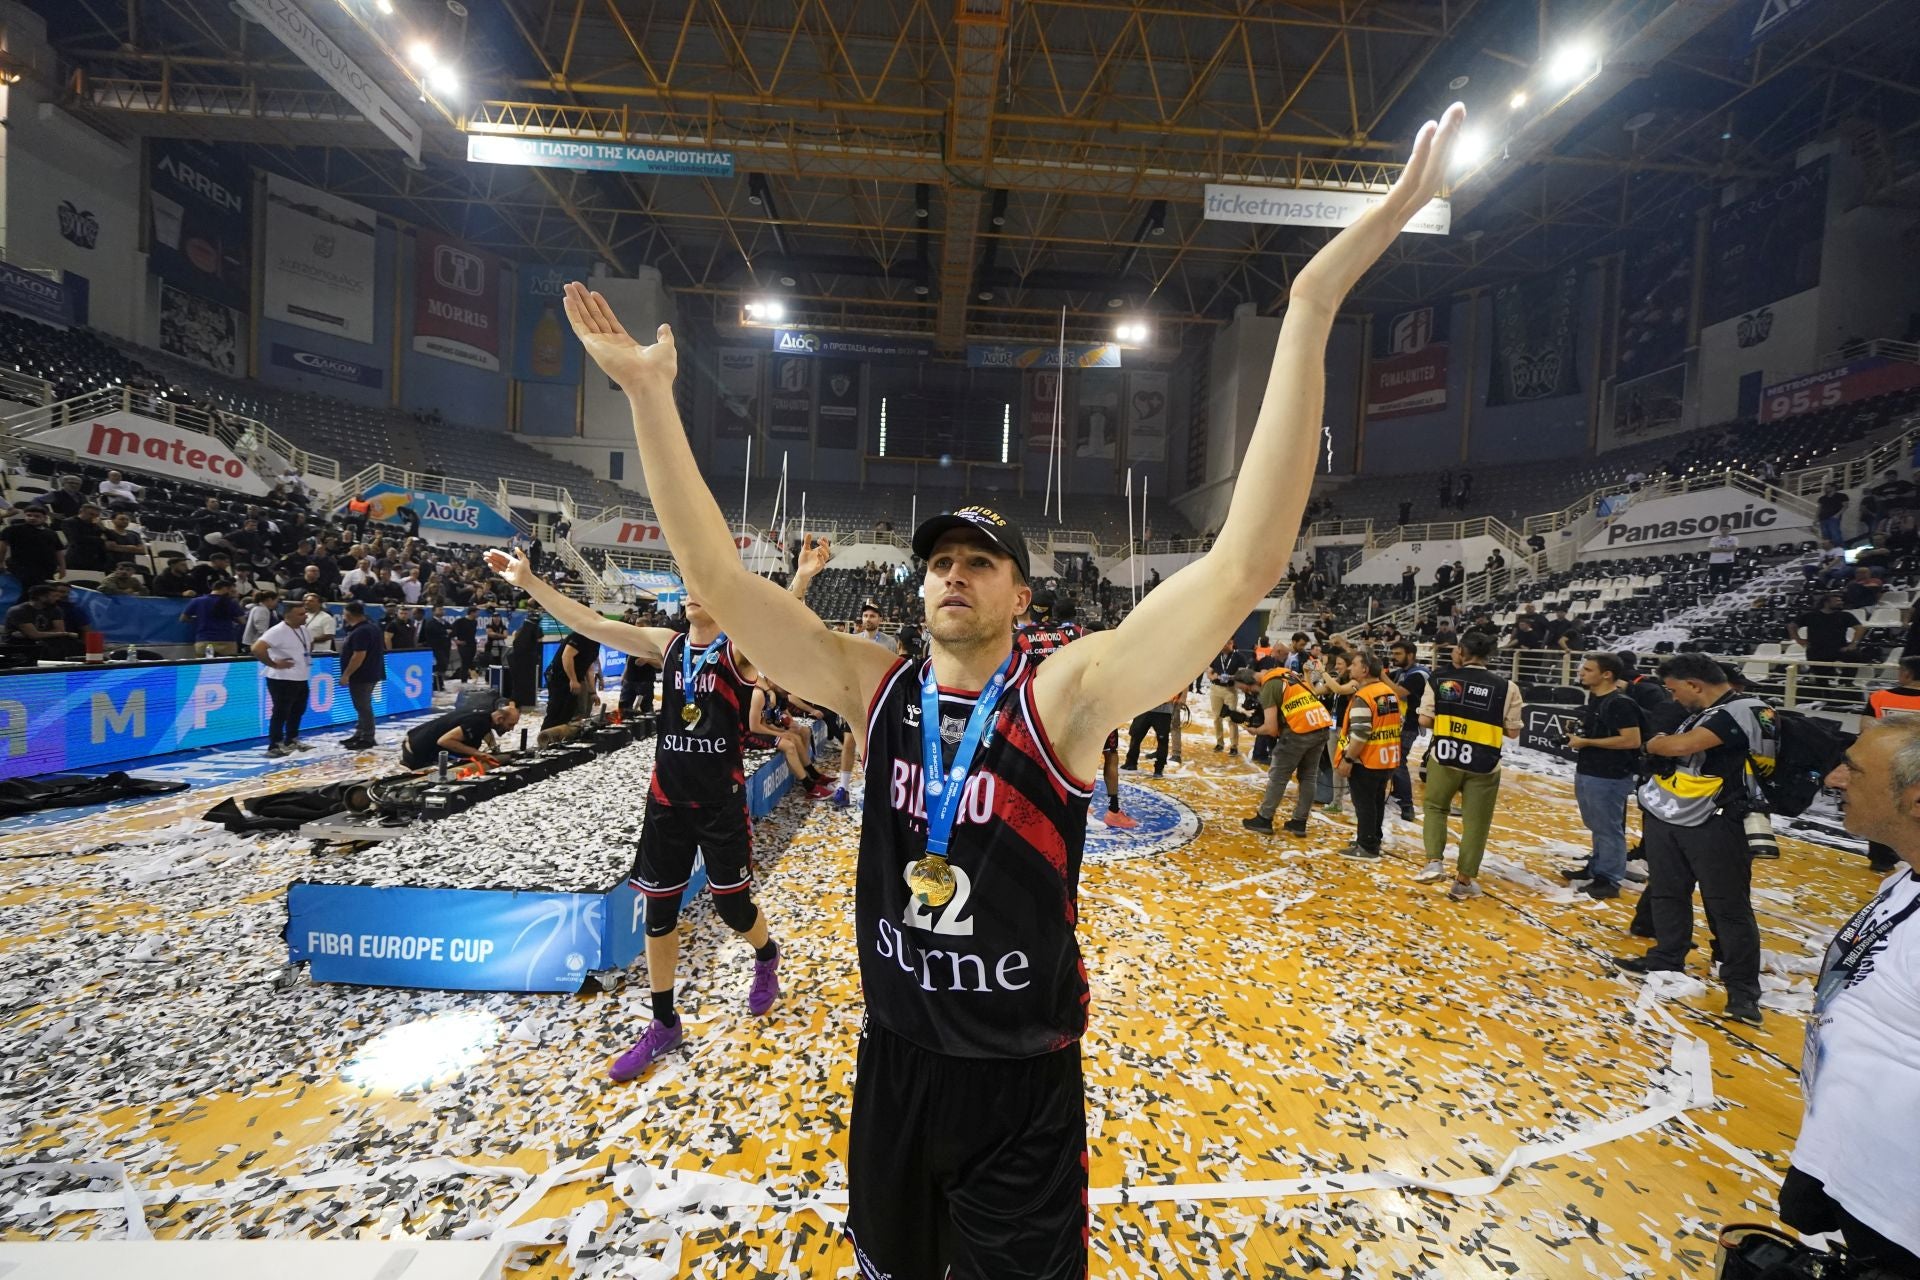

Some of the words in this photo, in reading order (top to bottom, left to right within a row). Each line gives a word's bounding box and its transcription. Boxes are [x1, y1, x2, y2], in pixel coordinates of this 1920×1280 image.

[541, 143, 593, 157] ΓΙΑΤΡΟΙ
[596, 146, 623, 159] ΤΗΣ
[626, 148, 731, 166] ΚΑΘΑΡΙΟΤΗΤΑΣ
[1208, 193, 1348, 221] ticketmaster
[530, 275, 564, 296] λου
[428, 298, 489, 329] MORRIS
[779, 332, 814, 353] Διός
[1767, 366, 1849, 397] METROPOLIS
[1771, 381, 1842, 418] 95.5
[87, 423, 244, 478] mateco
[424, 500, 479, 528] λουξ
[1608, 504, 1777, 545] Panasonic
[1028, 632, 1062, 642] BAGAYOKO
[1034, 646, 1062, 654] CORRE
[674, 670, 717, 693] BBAO
[1468, 685, 1489, 697] FIBA
[663, 734, 727, 754] surne
[1437, 738, 1473, 764] 068
[889, 758, 996, 825] BILO
[308, 931, 353, 956] FIBA
[359, 936, 444, 962] EUROPE
[450, 938, 494, 963] CUP
